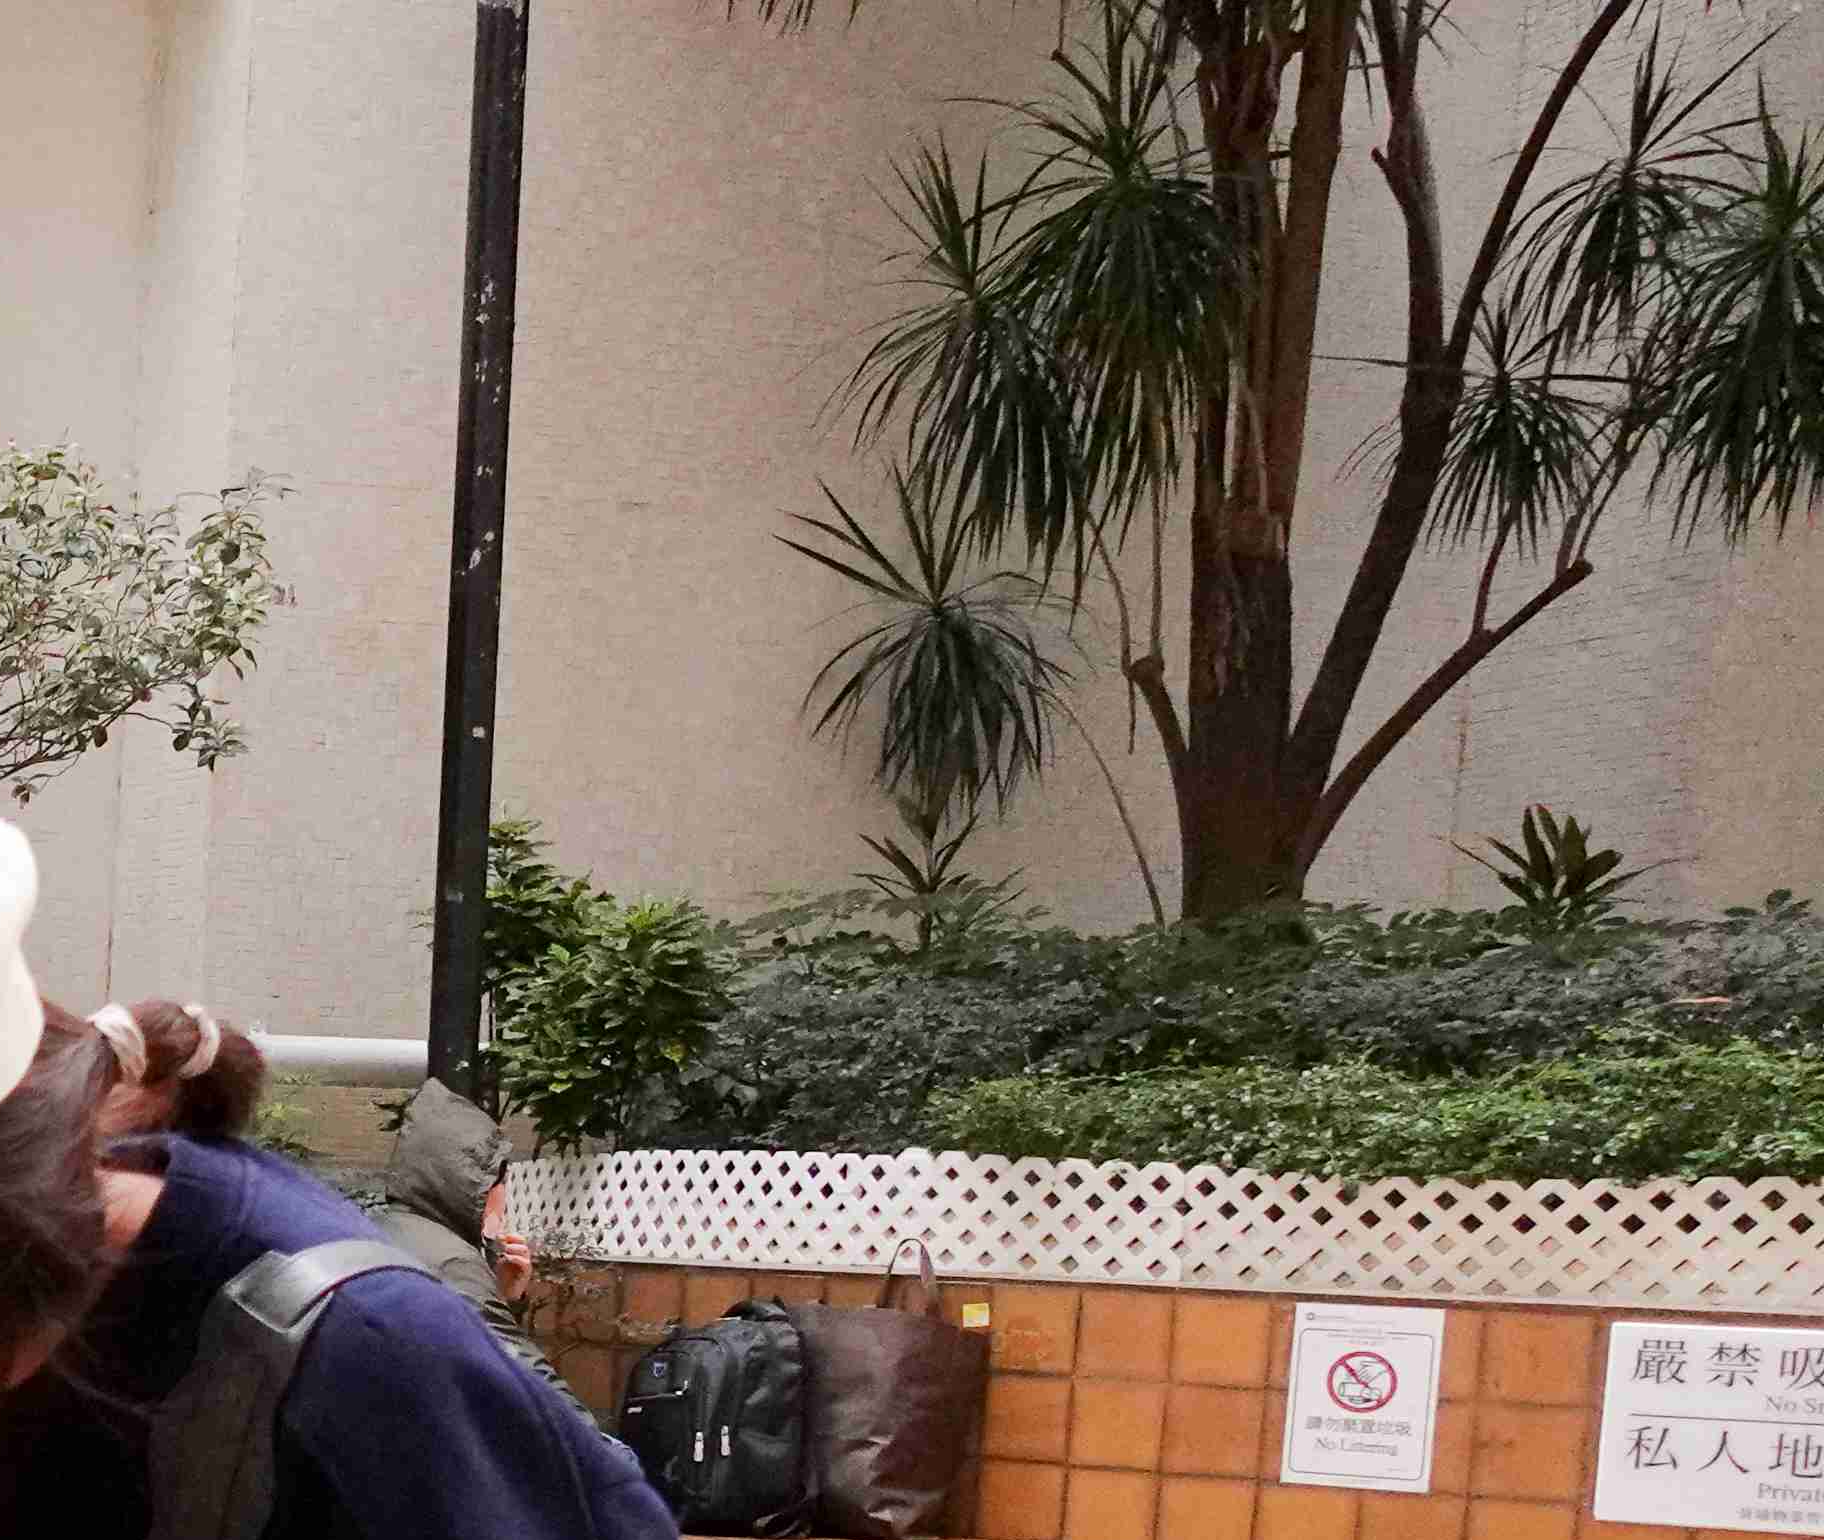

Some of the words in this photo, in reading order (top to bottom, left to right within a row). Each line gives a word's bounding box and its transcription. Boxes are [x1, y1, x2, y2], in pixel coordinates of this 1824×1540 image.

[1626, 1426, 1824, 1479] 私人地
[1757, 1483, 1824, 1505] Privat
